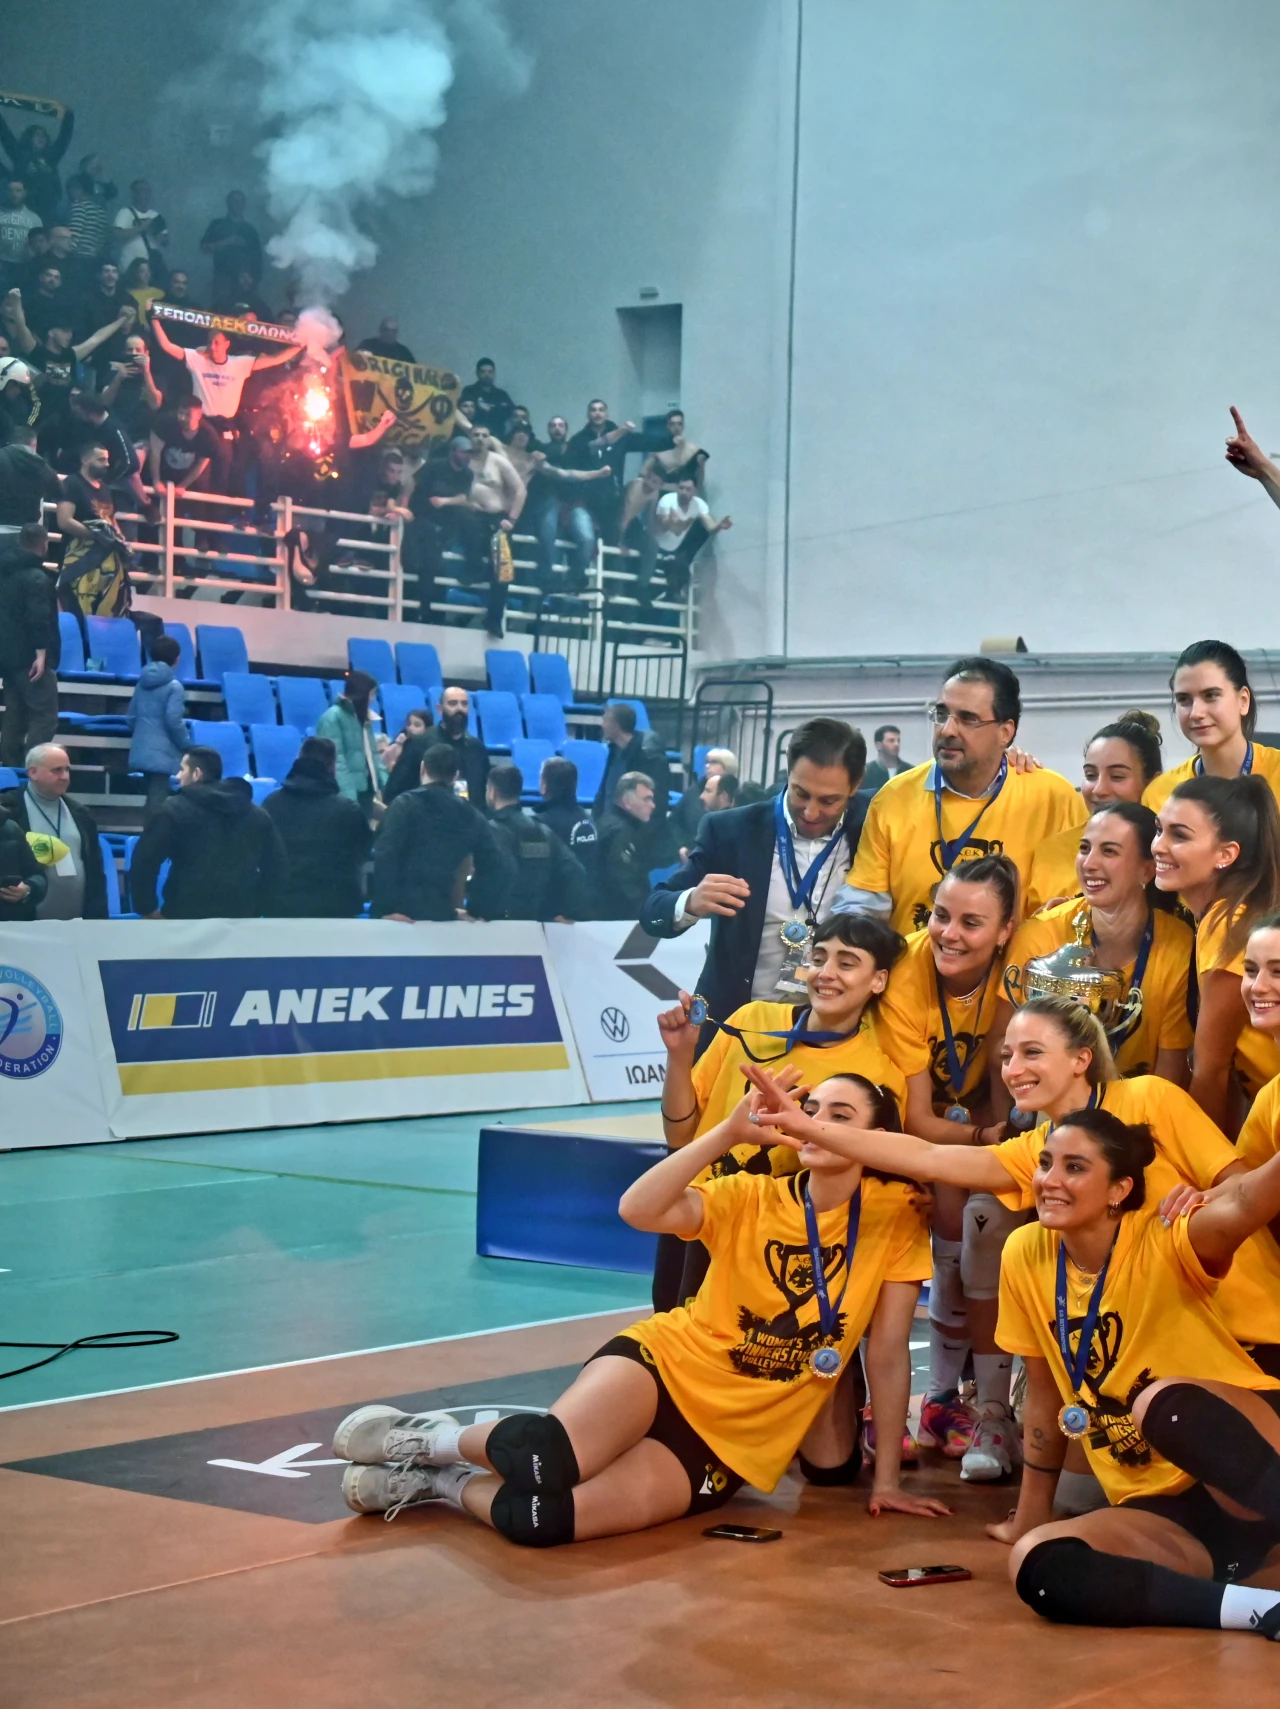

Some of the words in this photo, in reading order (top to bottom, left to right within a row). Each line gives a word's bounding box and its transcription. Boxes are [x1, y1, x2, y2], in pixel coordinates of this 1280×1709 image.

[230, 986, 393, 1027] ANEK
[401, 983, 535, 1020] LINES
[757, 1331, 803, 1349] WOMEN'S
[741, 1354, 796, 1371] VOLLEYBALL
